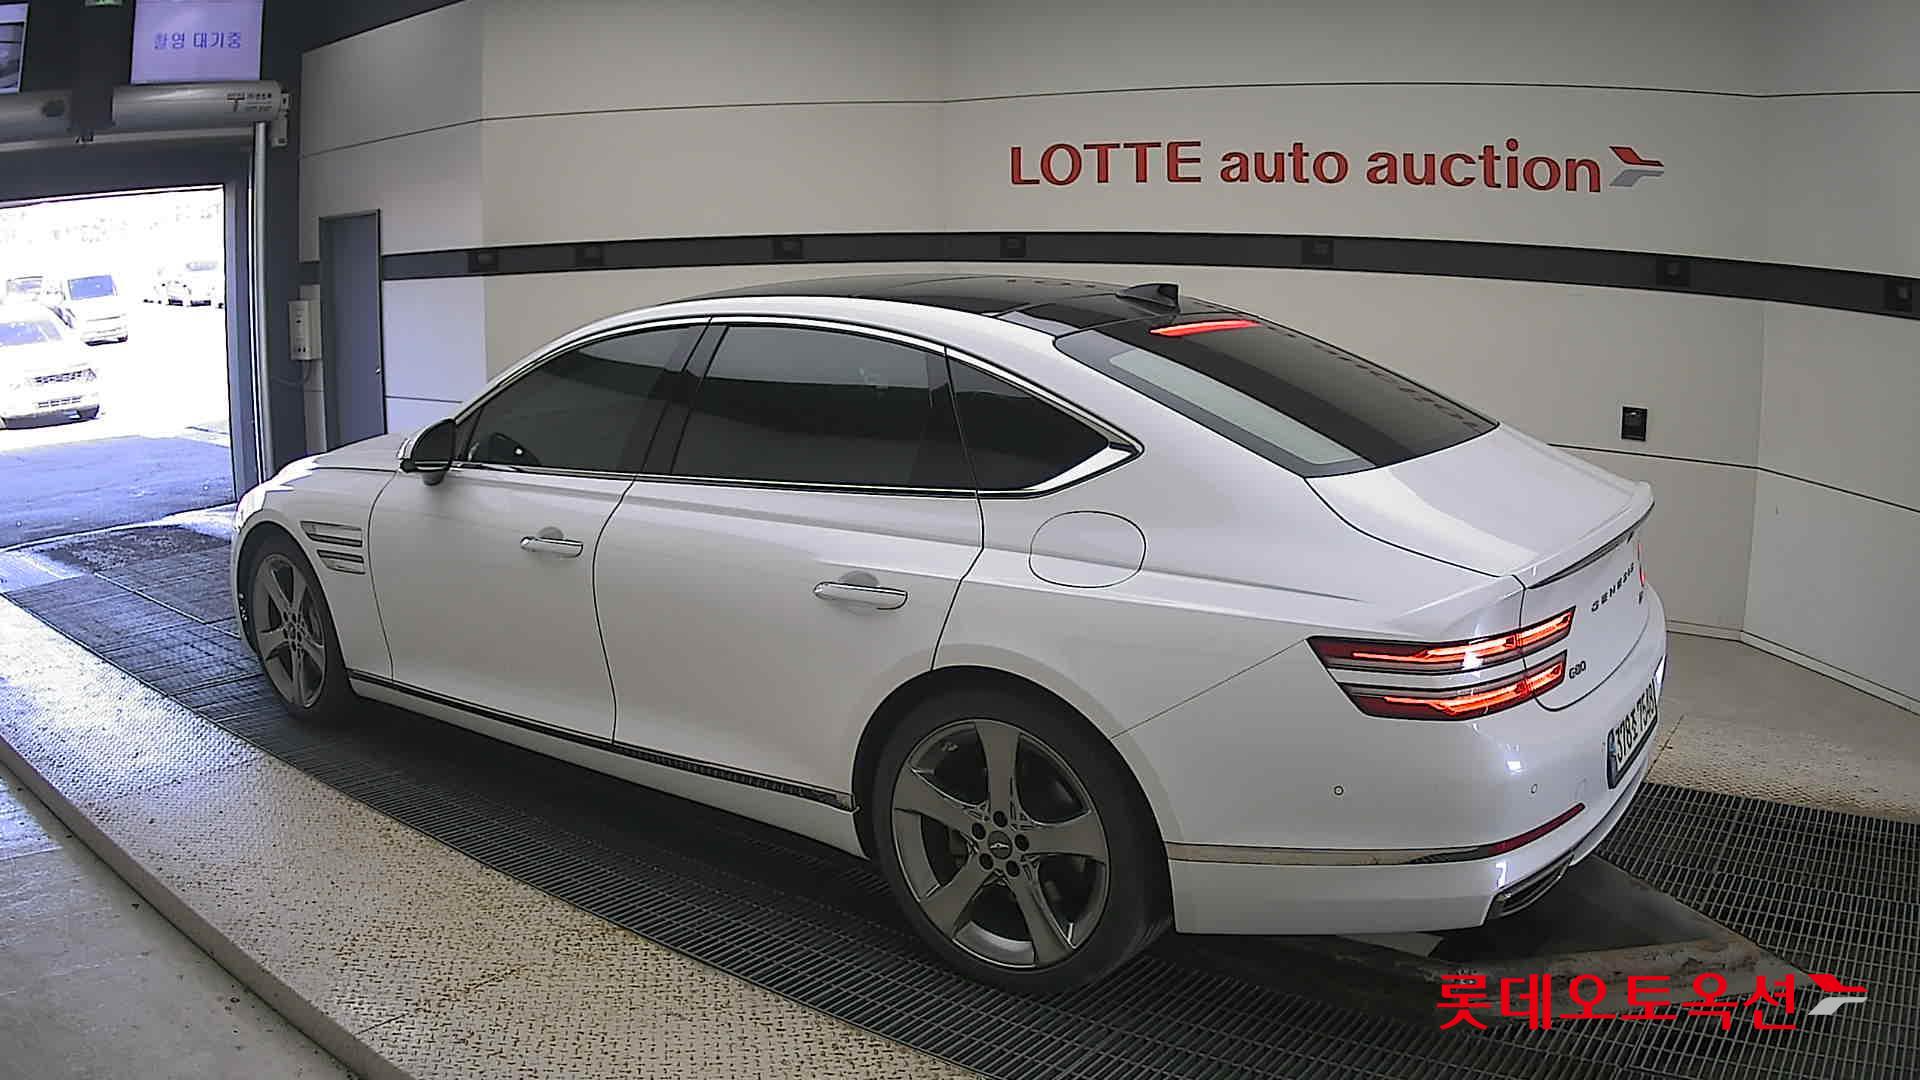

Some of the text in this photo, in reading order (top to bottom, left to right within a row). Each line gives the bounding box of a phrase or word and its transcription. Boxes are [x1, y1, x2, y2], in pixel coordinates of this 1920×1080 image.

[193, 32, 241, 49] 대기중
[1010, 137, 1602, 193] LOTTE auto auction
